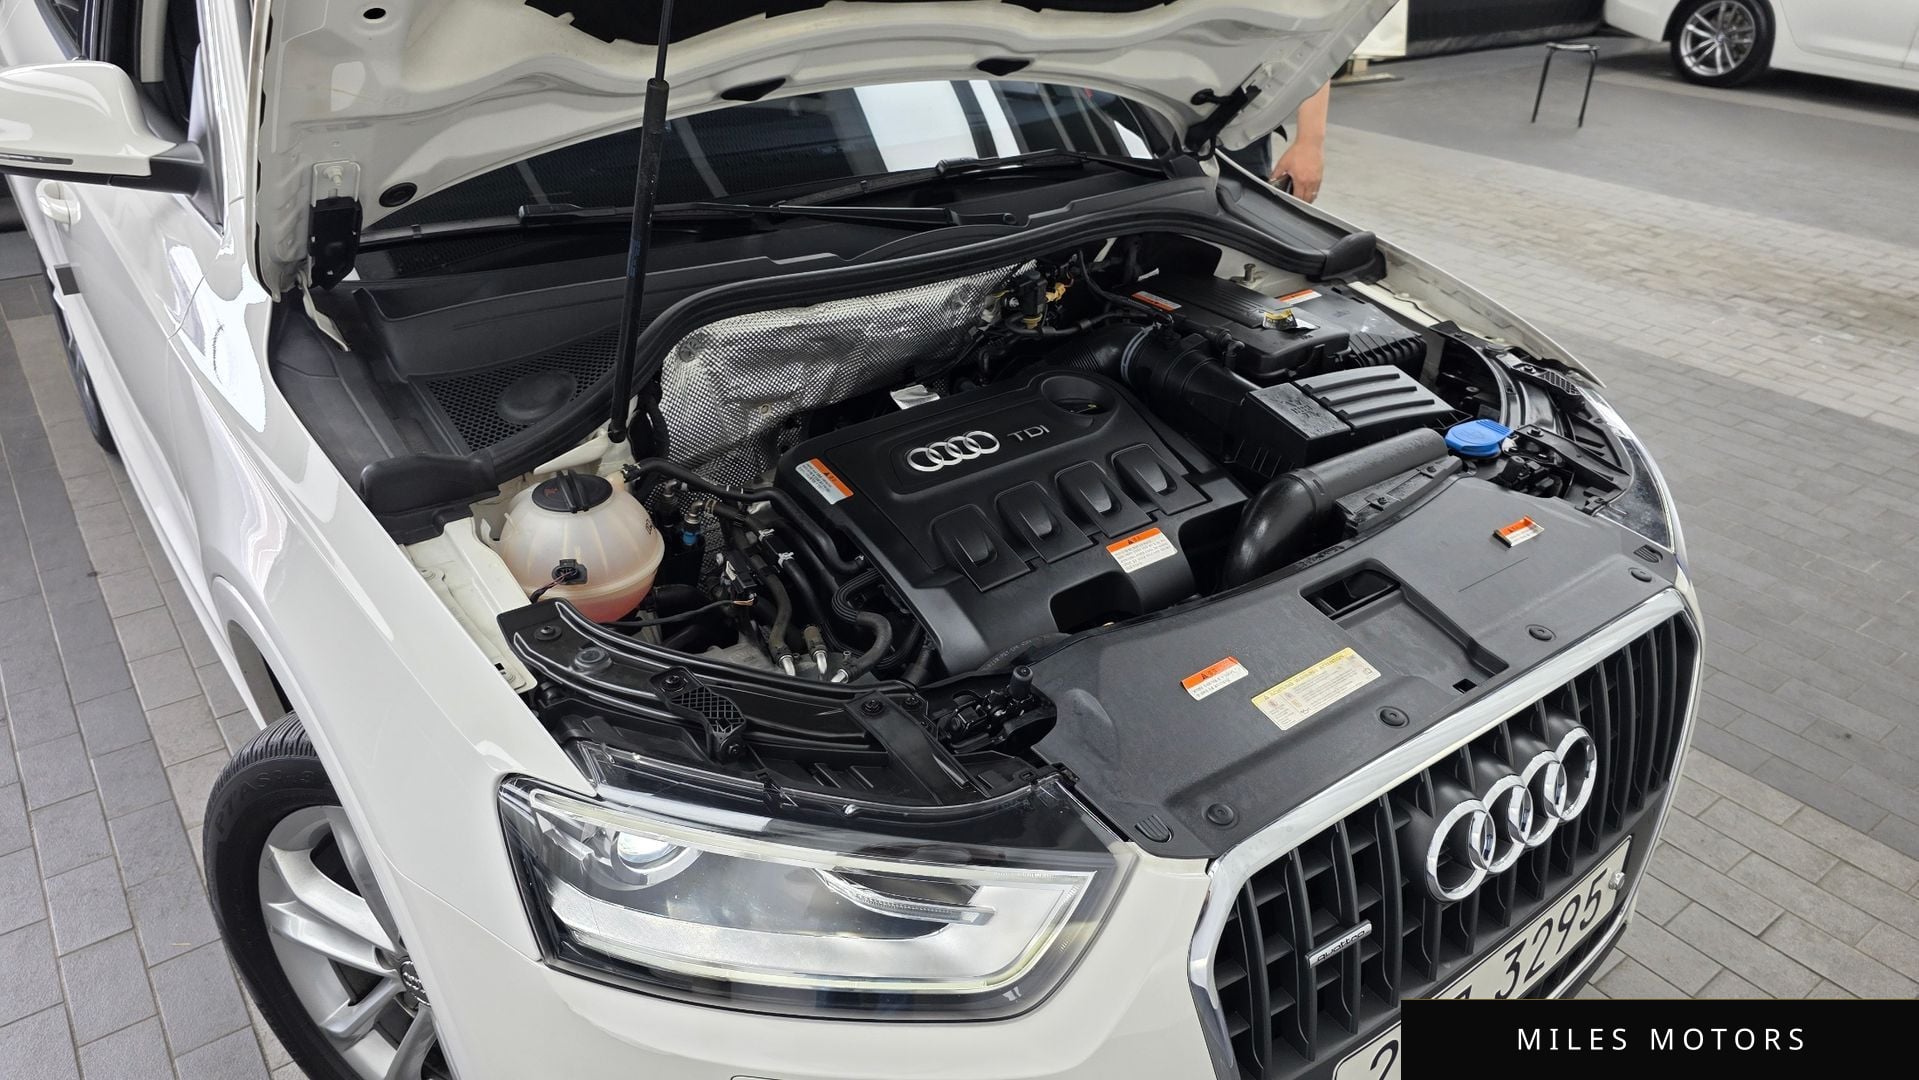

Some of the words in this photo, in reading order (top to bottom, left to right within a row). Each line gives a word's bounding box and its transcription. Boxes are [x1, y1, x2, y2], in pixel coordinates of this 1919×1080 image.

[1007, 424, 1050, 441] TDI
[1317, 930, 1365, 962] quattro
[1494, 867, 1609, 1000] 3295
